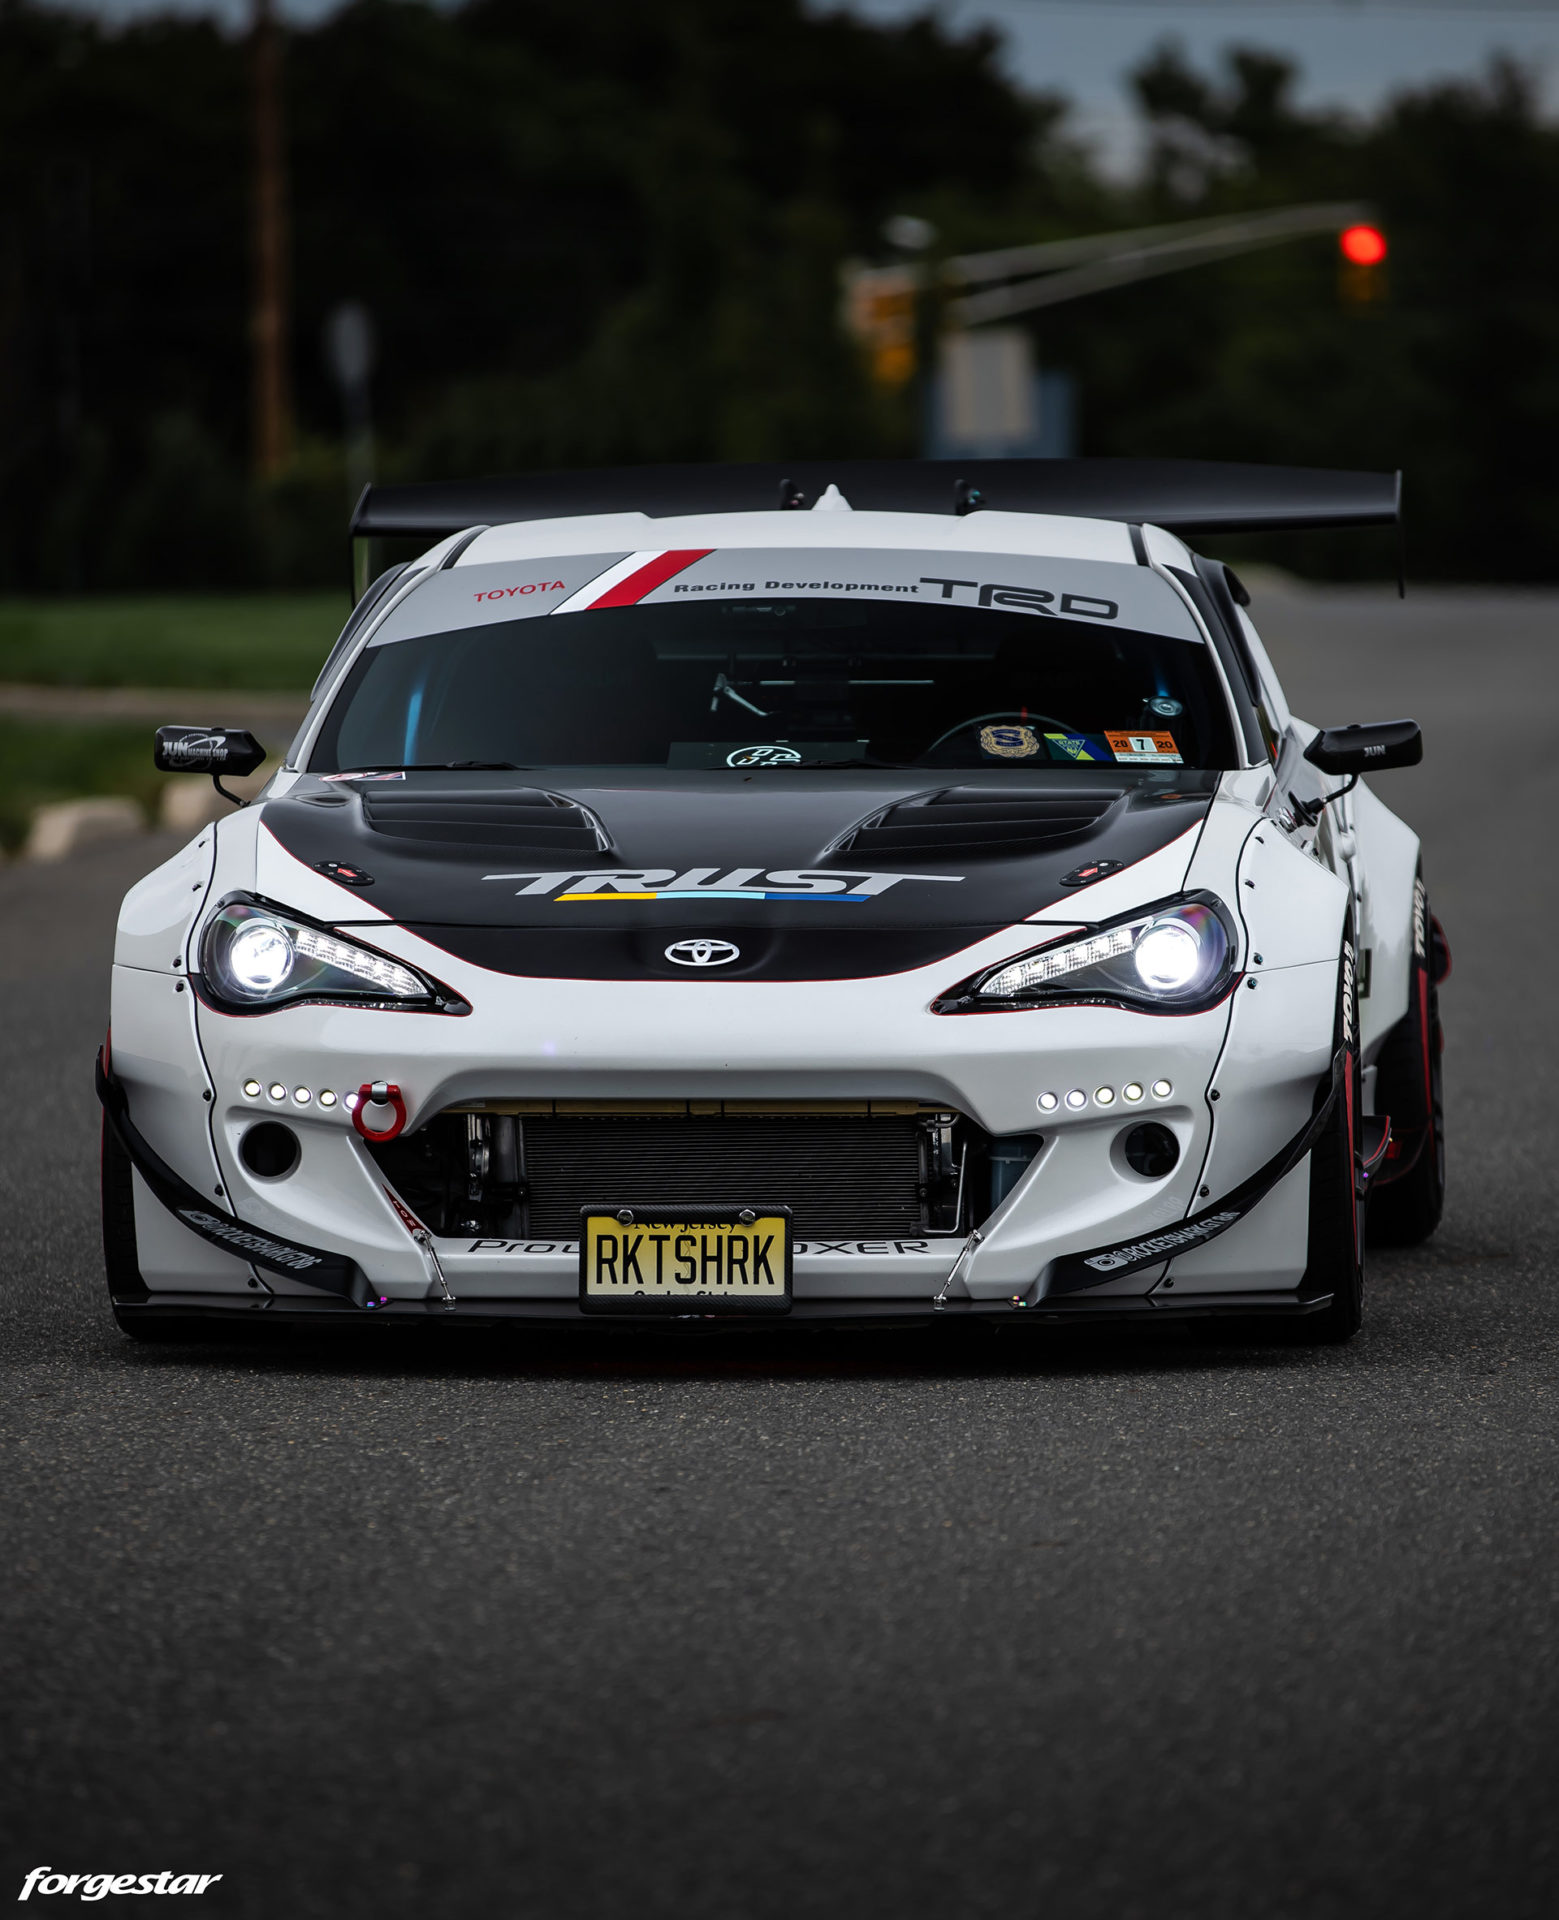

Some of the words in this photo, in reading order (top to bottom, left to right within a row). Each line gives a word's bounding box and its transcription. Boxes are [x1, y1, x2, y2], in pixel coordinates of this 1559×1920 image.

[474, 580, 566, 603] TOYOTA
[674, 582, 756, 594] Racing
[765, 580, 920, 594] Development
[920, 577, 1119, 620] TRD
[162, 742, 188, 757] JUN
[1112, 739, 1128, 749] 20
[1136, 738, 1145, 751] 7
[1156, 740, 1173, 750] 20
[1363, 745, 1386, 757] JUN
[481, 868, 966, 895] TRUST
[1343, 960, 1354, 1043] TOYO
[596, 1234, 775, 1285] RKTSHRK
